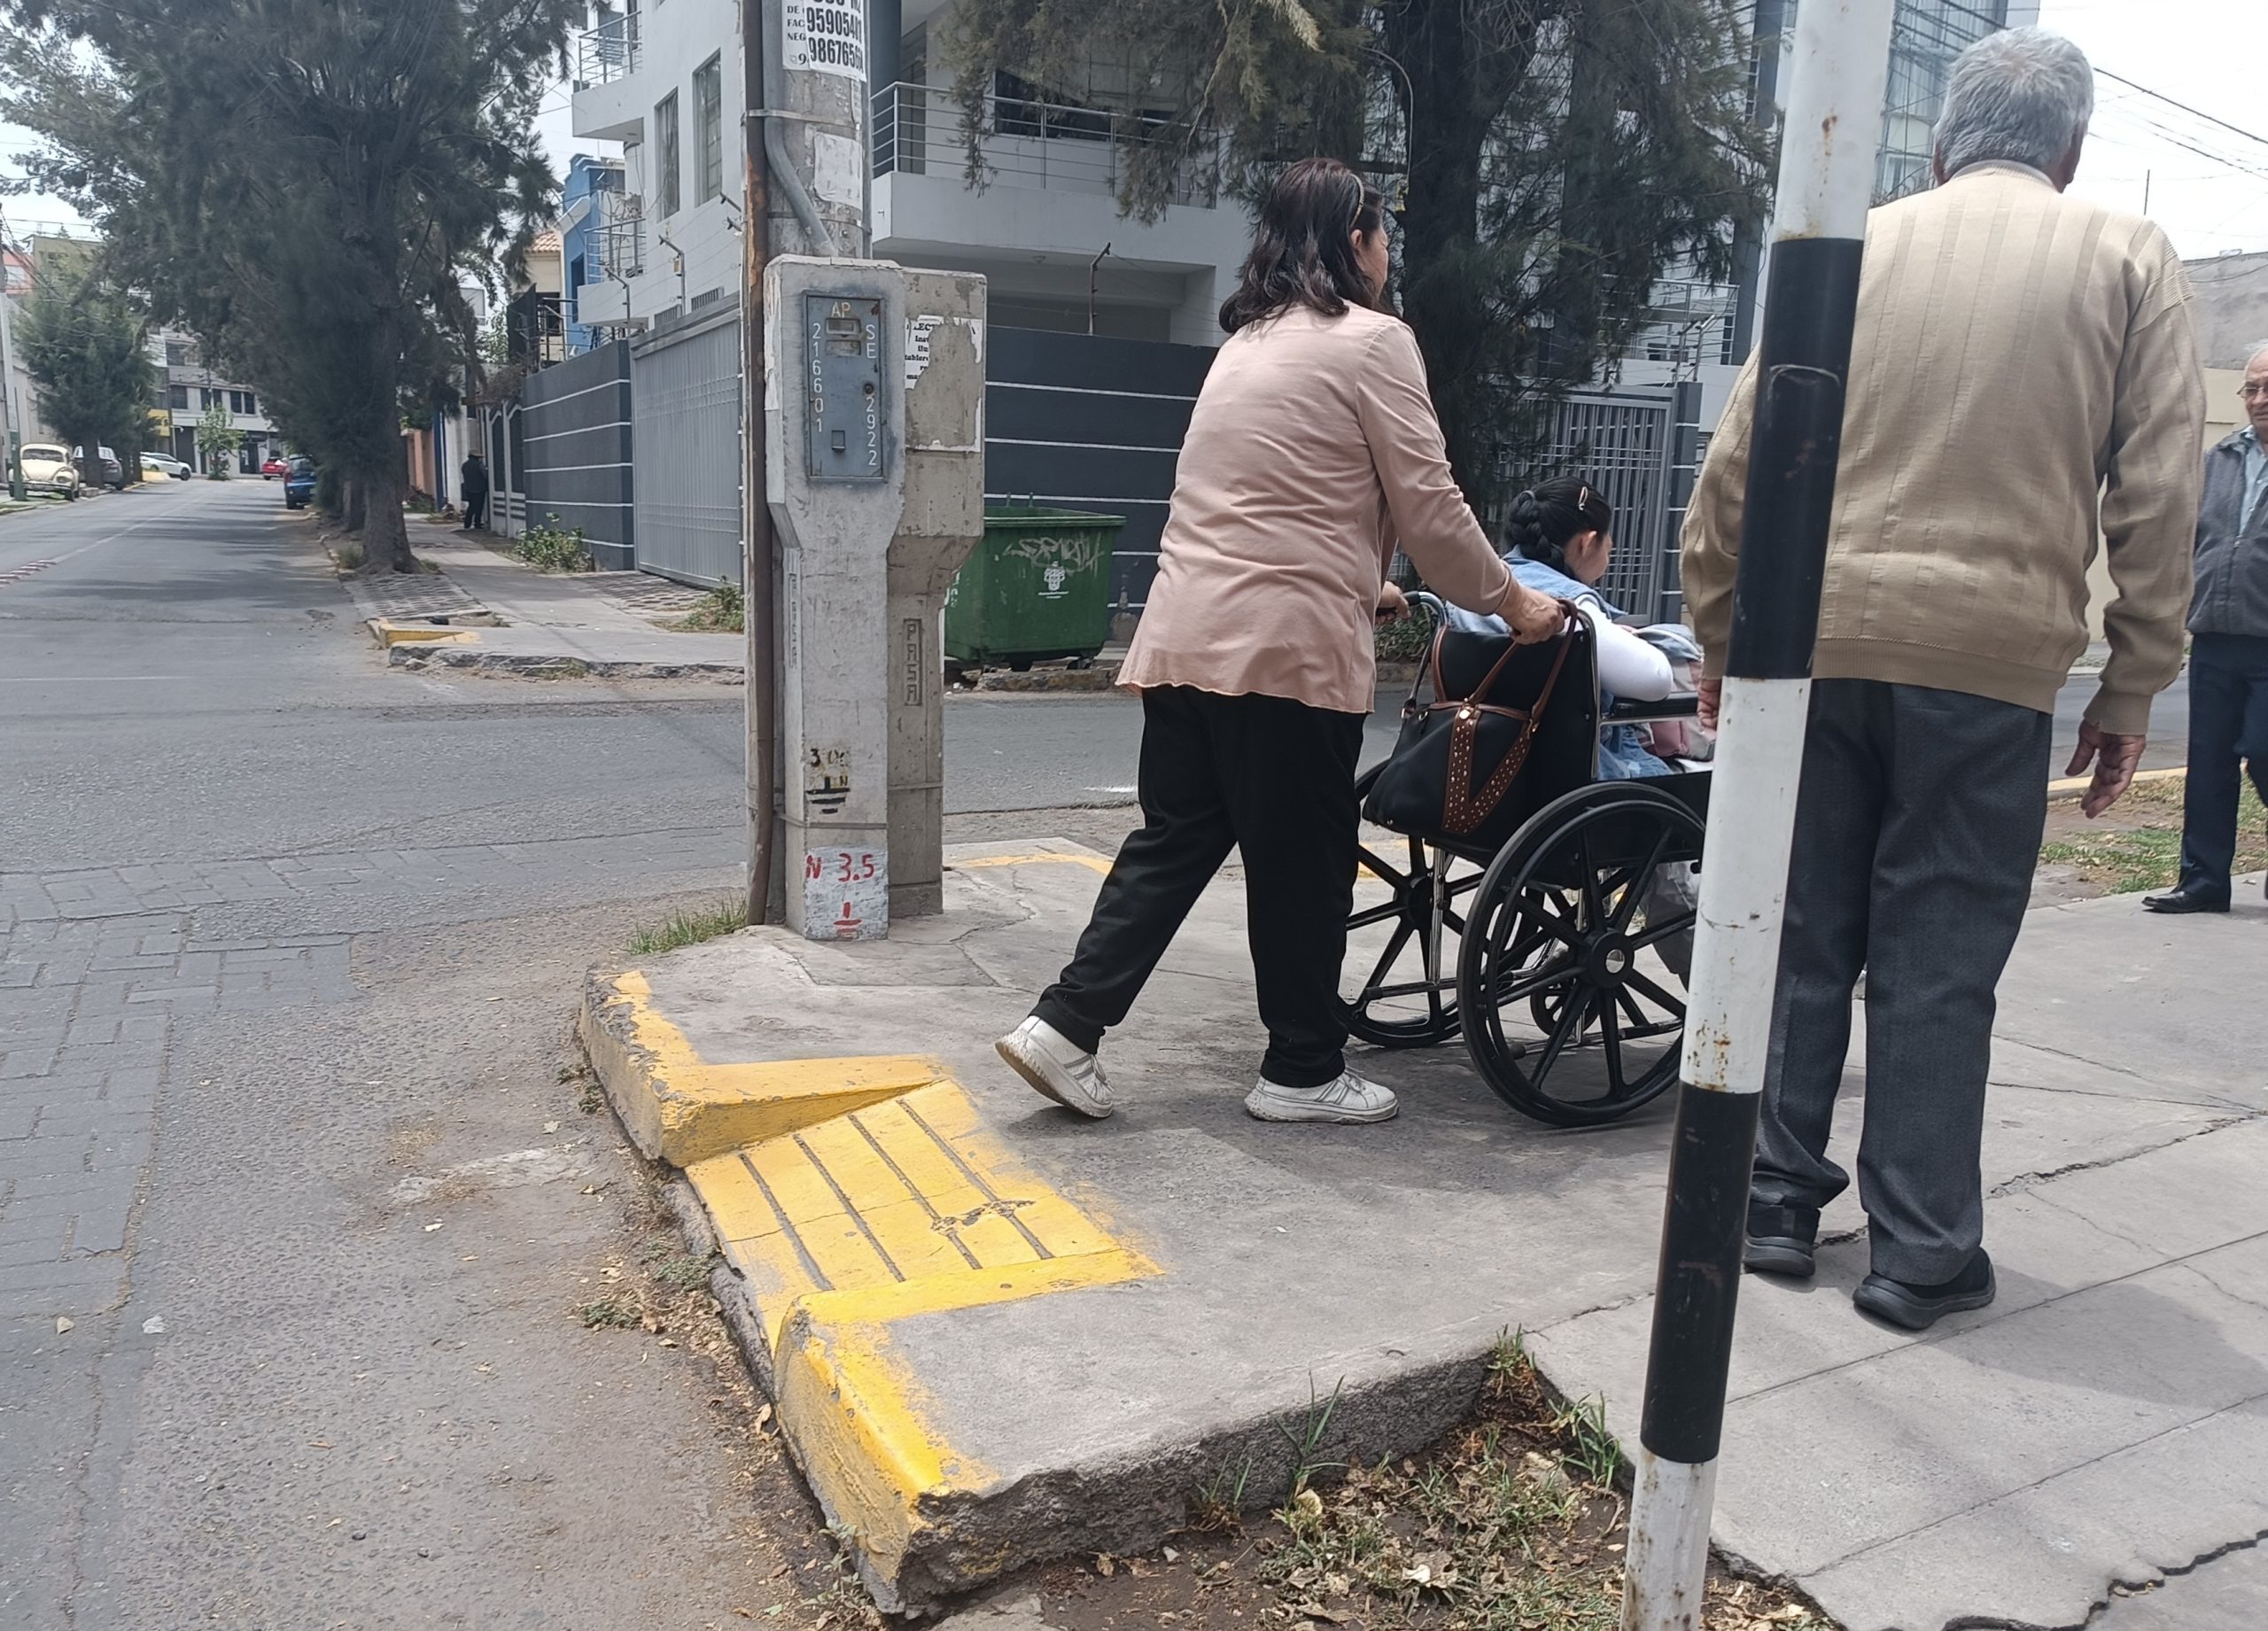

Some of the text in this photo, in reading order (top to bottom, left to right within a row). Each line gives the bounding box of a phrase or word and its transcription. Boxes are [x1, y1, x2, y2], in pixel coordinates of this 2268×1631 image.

[788, 5, 799, 14] DE
[831, 301, 850, 318] AP
[812, 322, 823, 432] 216601
[866, 396, 877, 466] 2922
[838, 852, 874, 882] 3.5
